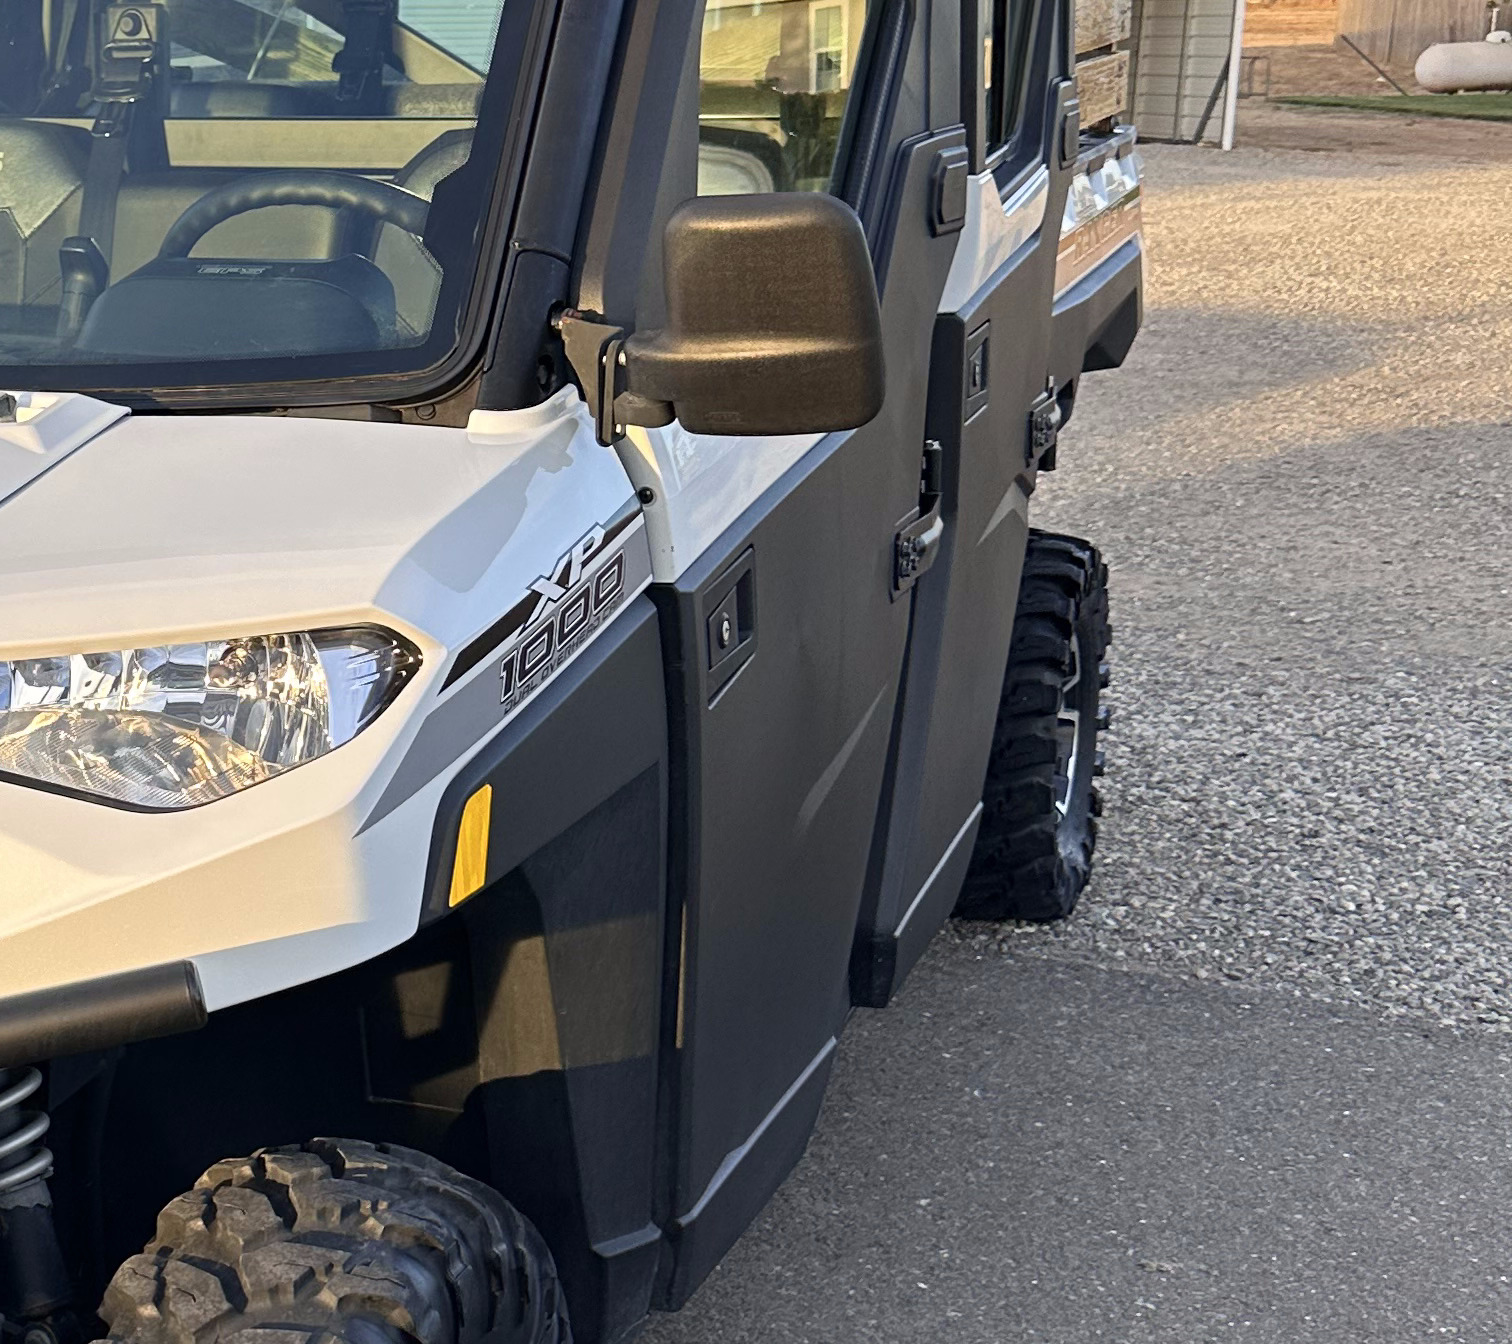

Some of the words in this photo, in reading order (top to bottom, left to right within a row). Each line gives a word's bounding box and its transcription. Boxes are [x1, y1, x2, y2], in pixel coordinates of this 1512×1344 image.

[500, 548, 627, 704] 1000
[516, 522, 606, 638] XP
[503, 679, 538, 715] DUAL
